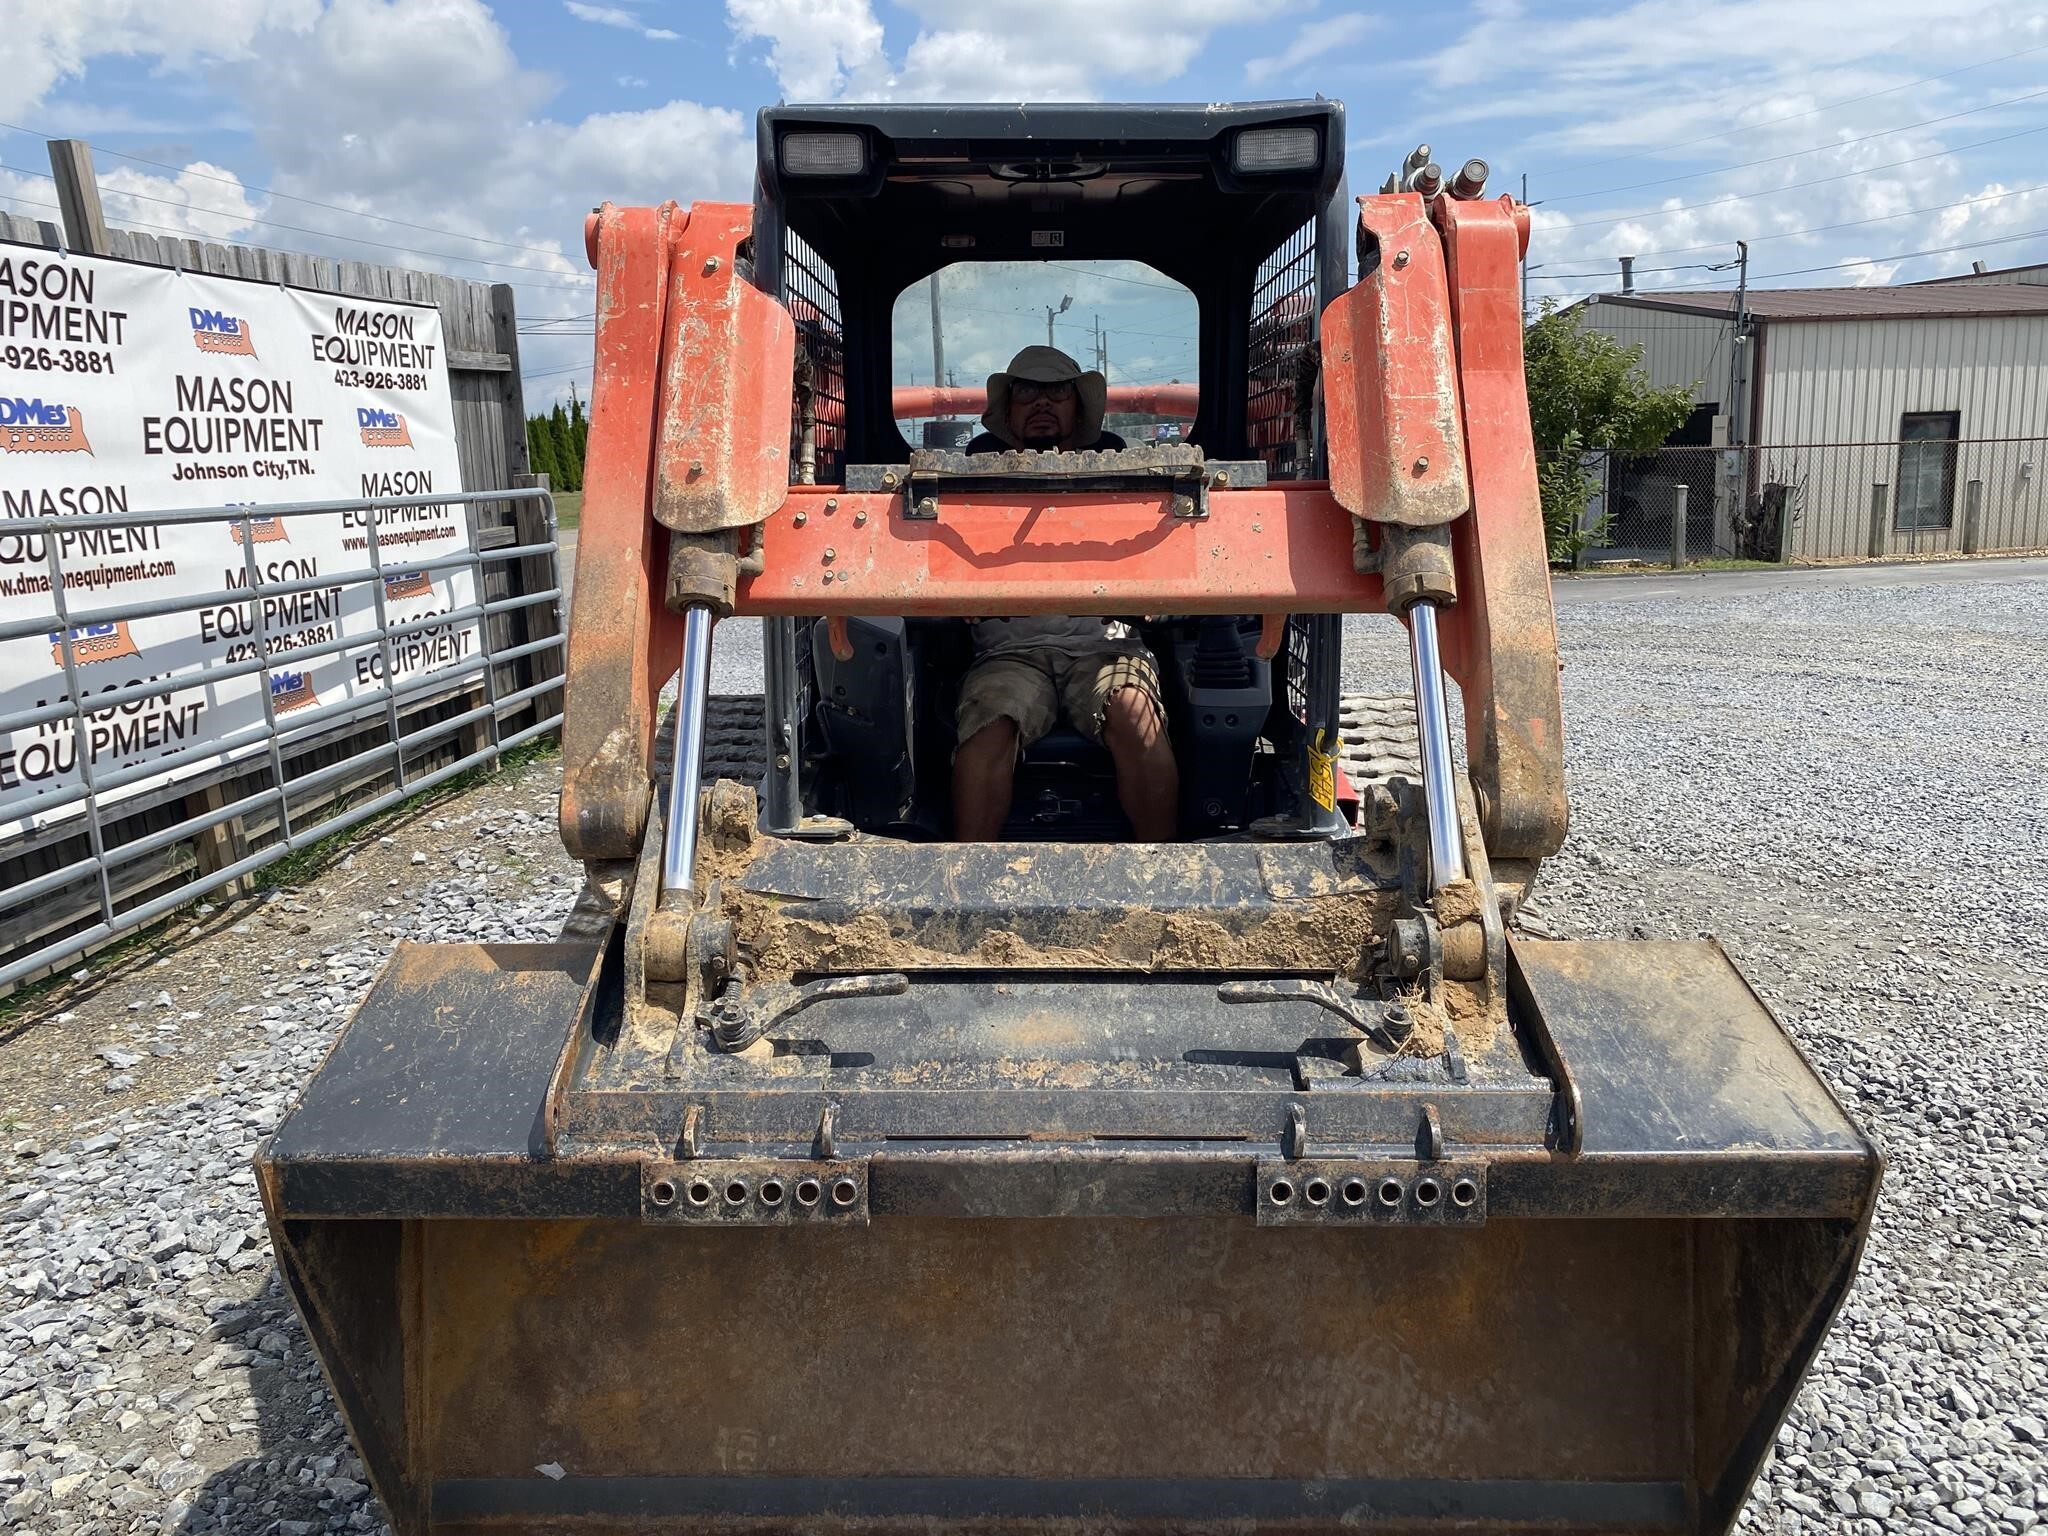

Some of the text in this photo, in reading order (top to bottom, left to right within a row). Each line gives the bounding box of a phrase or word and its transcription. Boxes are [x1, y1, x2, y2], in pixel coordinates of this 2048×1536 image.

[335, 307, 414, 340] MASON
[311, 334, 435, 370] EQUIPMENT
[175, 375, 293, 414] MASON
[334, 369, 427, 391] 423-926-3881
[142, 416, 323, 454] EQUIPMENT
[172, 462, 248, 481] Johnson
[361, 470, 433, 498] MASON
[2, 485, 128, 520] MASON
[0, 525, 160, 565] QUPMENT
[342, 525, 456, 551] www.asonequipment.com
[0, 560, 176, 597] w.dmanequipment.com
[200, 587, 343, 644] EQUPMENT
[225, 624, 334, 664] 423926-3881
[0, 701, 205, 791] EQUPMENT
